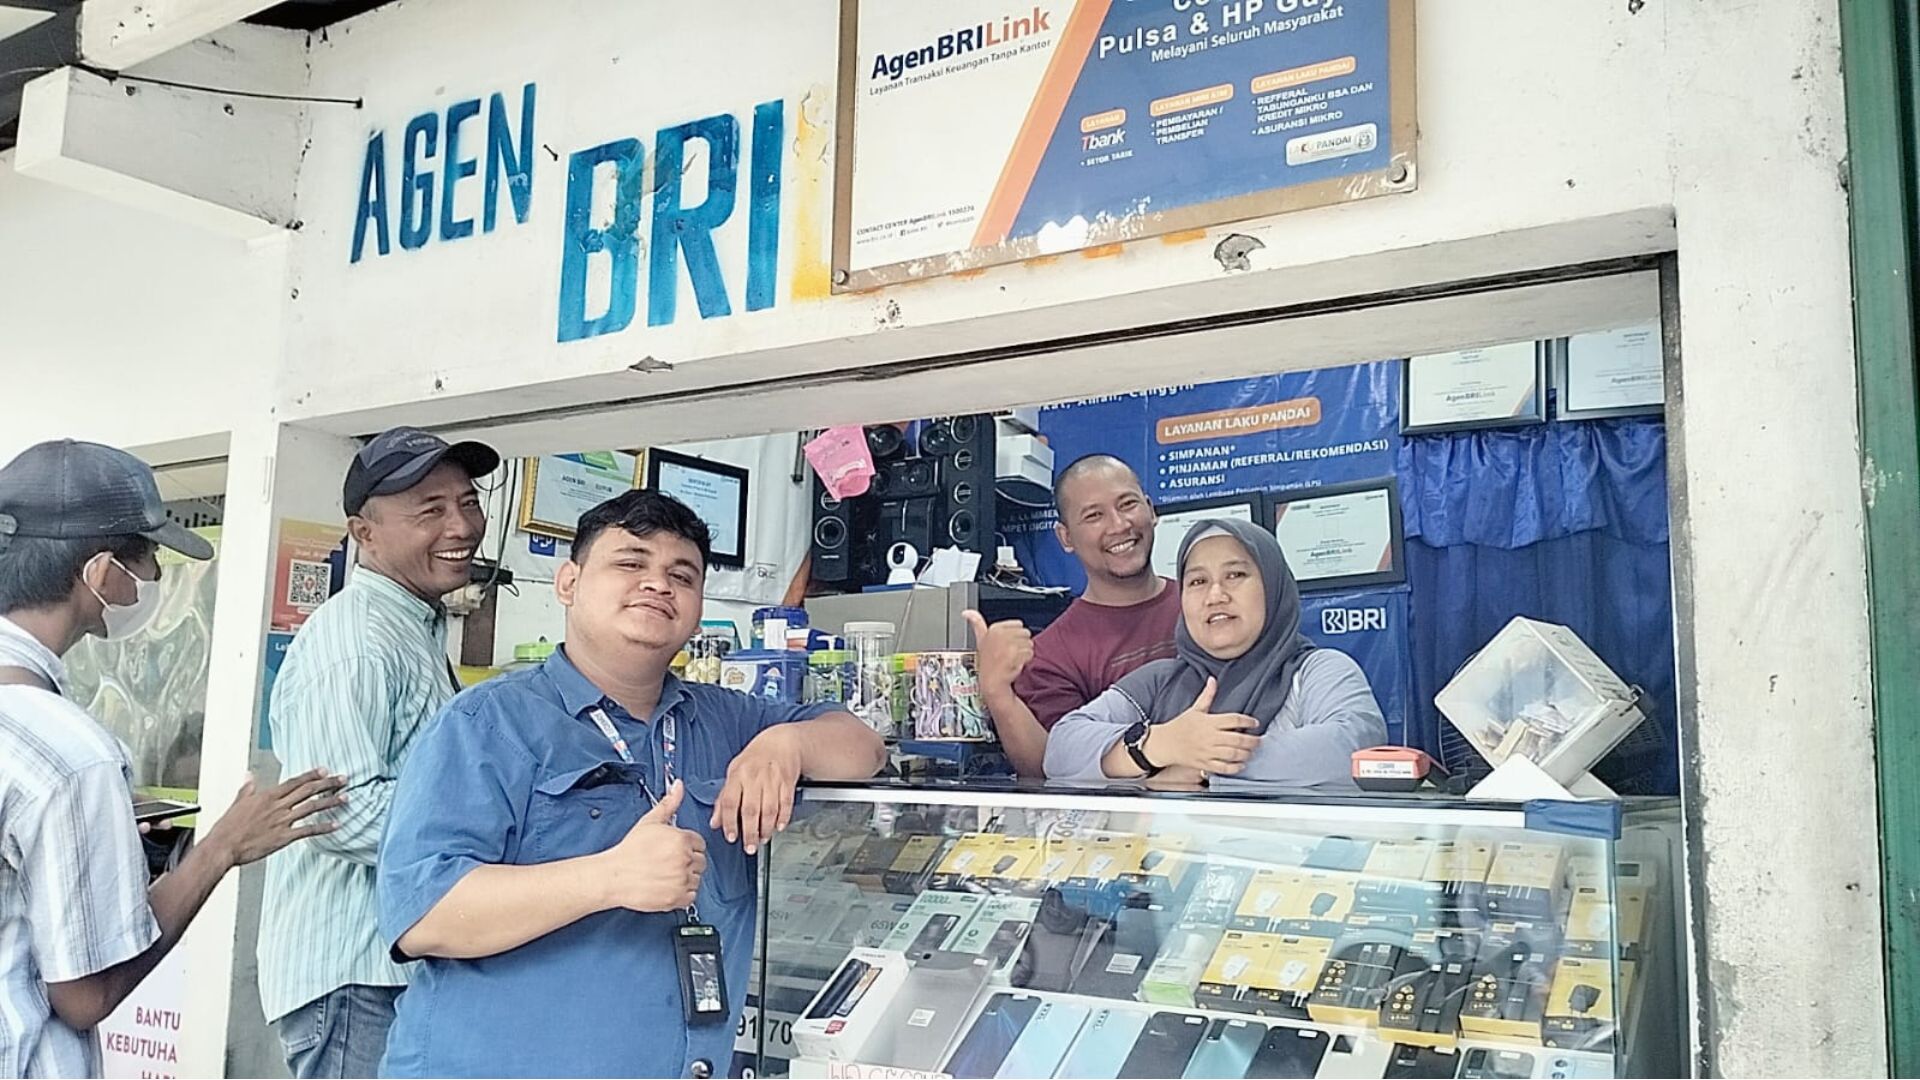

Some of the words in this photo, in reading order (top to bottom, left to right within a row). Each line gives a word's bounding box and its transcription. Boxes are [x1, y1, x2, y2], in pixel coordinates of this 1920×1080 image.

[1099, 24, 1177, 58] Pulsa
[1190, 12, 1209, 35] &
[1222, 0, 1263, 28] HP
[1151, 39, 1208, 62] Melayani
[1211, 26, 1260, 48] Seluruh
[1264, 5, 1344, 35] Masyarakat
[871, 7, 1050, 80] AgenBRILink
[869, 80, 903, 96] Layanan
[905, 69, 944, 86] Transaksi
[945, 57, 989, 74] Keuangan
[991, 48, 1018, 63] Tanpa
[1020, 39, 1051, 54] Kantor
[1257, 88, 1308, 105] REFFERAL
[1257, 93, 1325, 114] TABUNGANKU
[1327, 89, 1349, 99] BSA
[1350, 82, 1373, 95] DAN
[1156, 107, 1217, 128] PEMBAYARAN
[1257, 108, 1293, 123] KREDIT
[1294, 101, 1328, 115] MIKRO
[1257, 118, 1308, 135] ASURANSI
[1309, 110, 1343, 125] MIKRO
[1156, 119, 1208, 136] PEMBELIAN
[1156, 128, 1204, 145] TRANSFER
[1316, 135, 1352, 150] PANDAI
[350, 82, 536, 264] AGEN
[557, 99, 784, 342] BRI
[1164, 419, 1222, 437] LAYANAN
[1224, 413, 1260, 429] LAKU
[1263, 406, 1311, 423] PANDAI
[1168, 457, 1228, 475] PINJAMAN
[1230, 438, 1389, 469] (REFERRAL/REKOMENDASI)
[1169, 473, 1225, 489] ASURANSI
[1347, 607, 1386, 631] BRI
[136, 1006, 181, 1031] BANTU
[106, 1031, 178, 1064] KEBUTUHA
